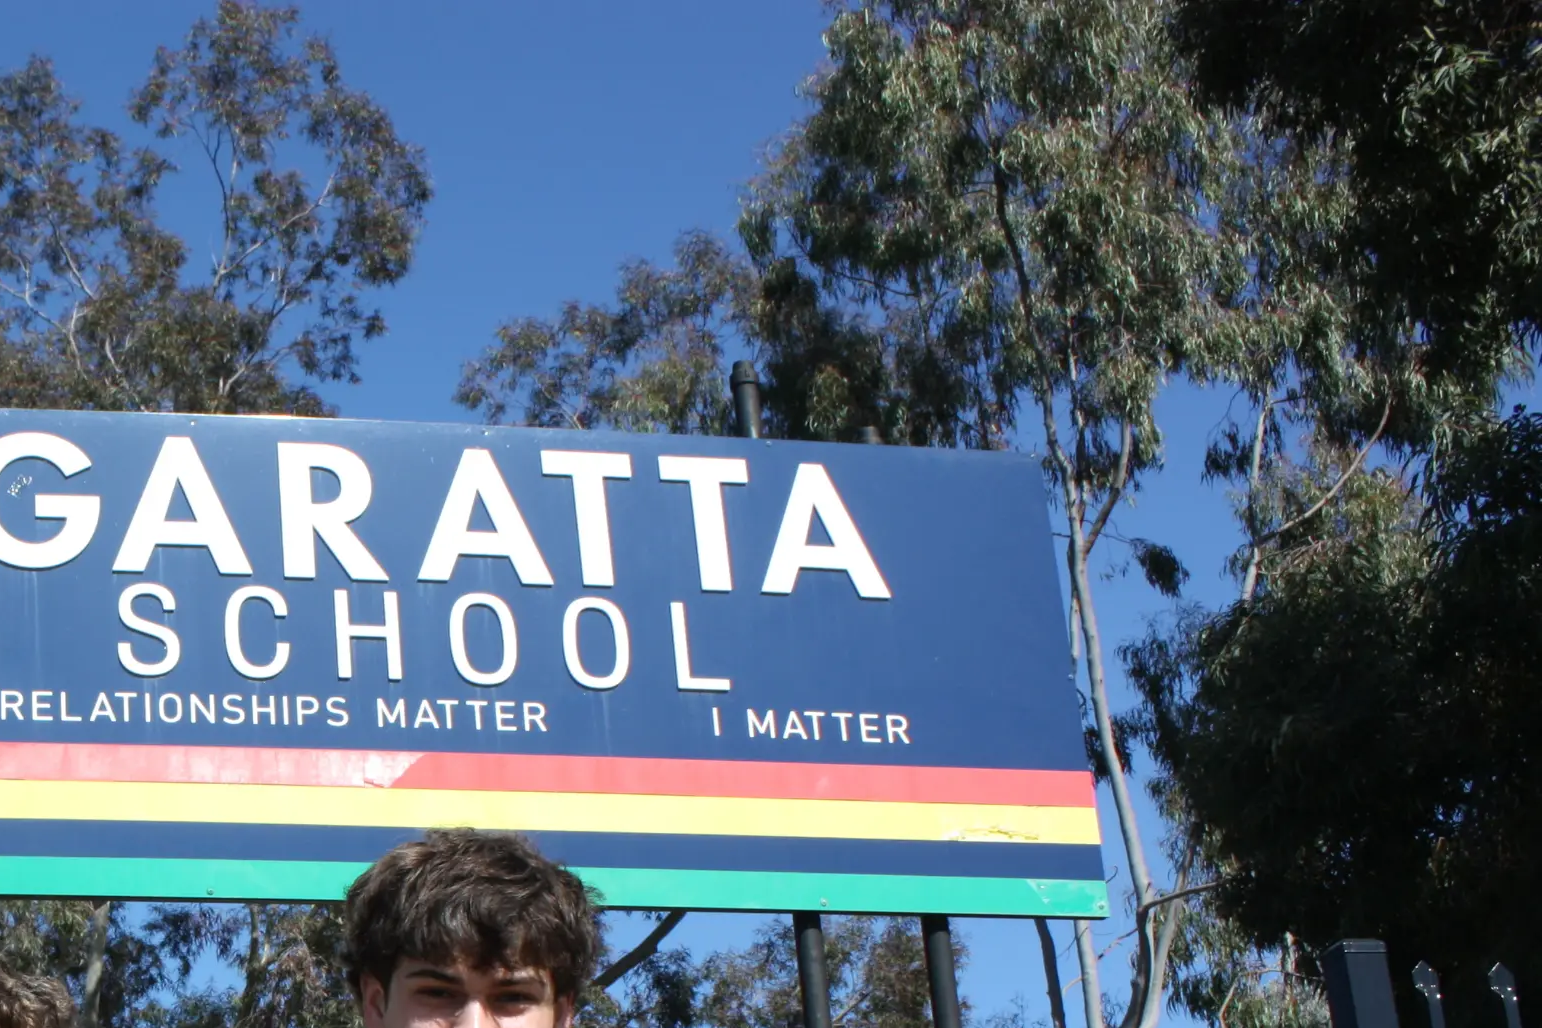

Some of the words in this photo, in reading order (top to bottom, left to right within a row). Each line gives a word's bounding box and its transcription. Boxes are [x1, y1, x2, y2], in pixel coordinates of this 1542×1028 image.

[115, 582, 732, 693] SCHOOL
[0, 689, 350, 727] RELATIONSHIPS
[376, 697, 549, 733] MATTER
[711, 707, 722, 738] I
[747, 708, 911, 745] MATTER
